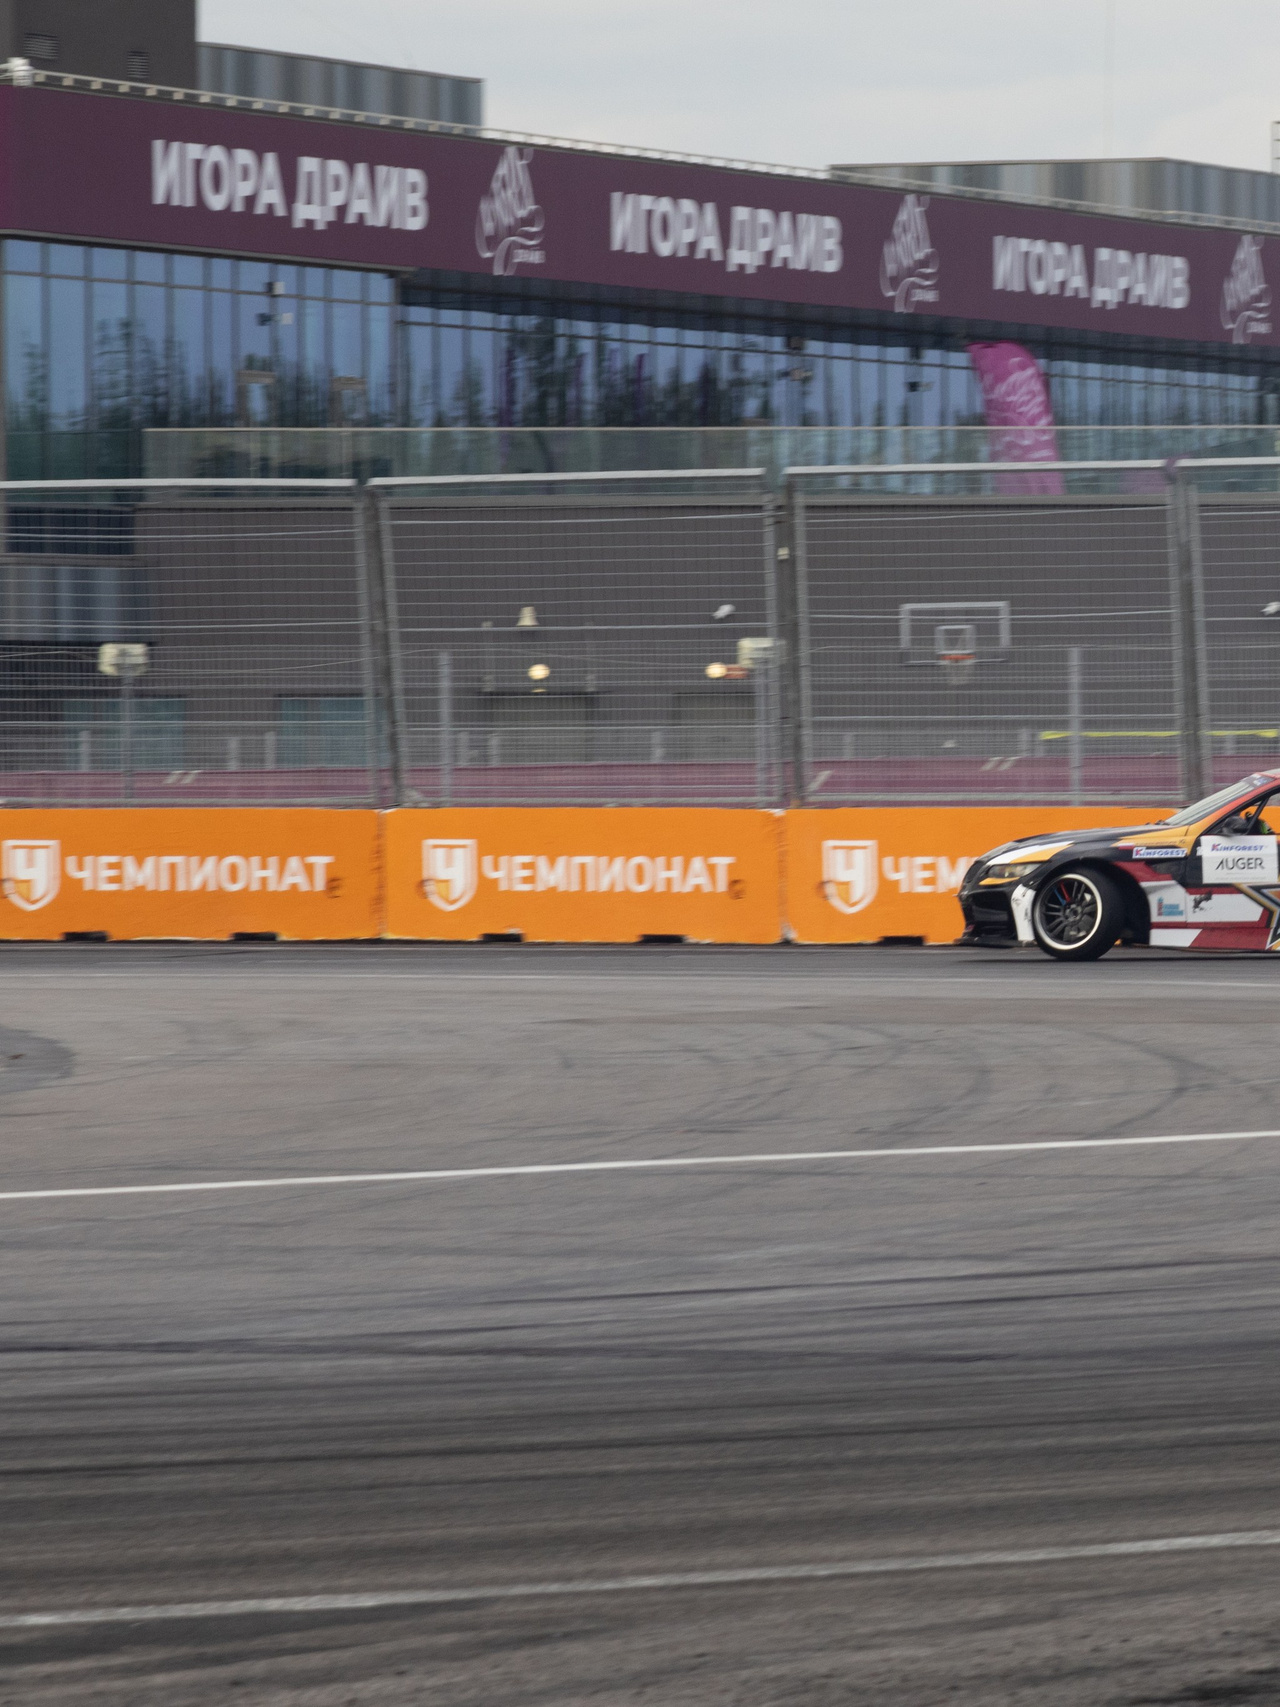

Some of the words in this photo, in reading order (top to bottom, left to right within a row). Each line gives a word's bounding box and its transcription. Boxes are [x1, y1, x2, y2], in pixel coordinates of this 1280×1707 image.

[150, 138, 289, 217] ИГОРА
[610, 191, 724, 262] ИГОРА
[992, 235, 1090, 299] ИГОРА
[1135, 847, 1187, 858] KINFOREST
[1211, 843, 1264, 852] KINFOREST
[1215, 857, 1266, 871] AUGER
[65, 854, 336, 892] ЧЕМПИОНАТ
[481, 854, 737, 892] ЧЕМПИОНАТ
[881, 855, 979, 894] ЧЕМ
